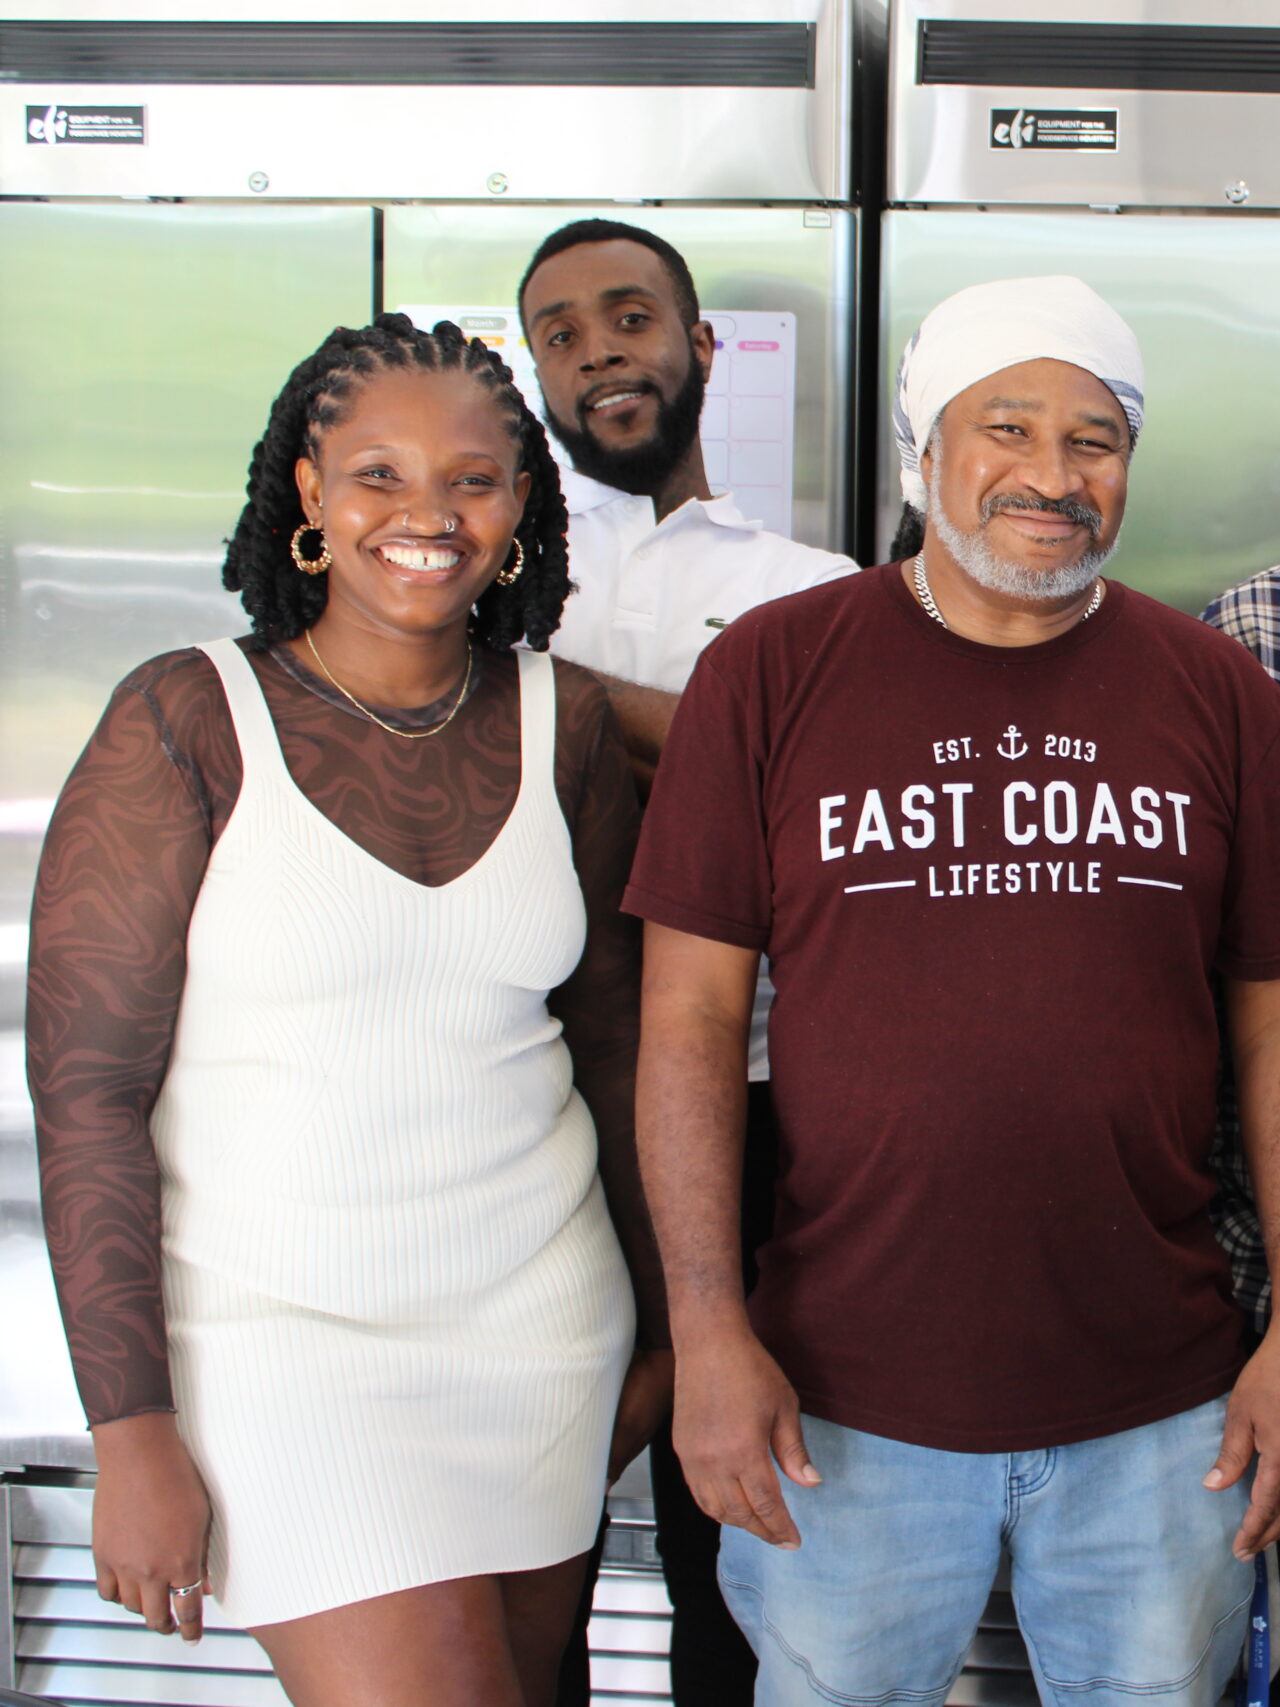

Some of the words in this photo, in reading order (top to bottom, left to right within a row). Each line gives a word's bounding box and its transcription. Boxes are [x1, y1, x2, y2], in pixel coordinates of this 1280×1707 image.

[994, 109, 1035, 148] efi
[1037, 120, 1080, 128] EQUIPMENT
[933, 737, 981, 764] EST.
[1044, 735, 1097, 763] 2013
[819, 783, 974, 862] EAST
[1003, 780, 1191, 856] COAST
[928, 861, 1102, 897] LIFESTYLE
